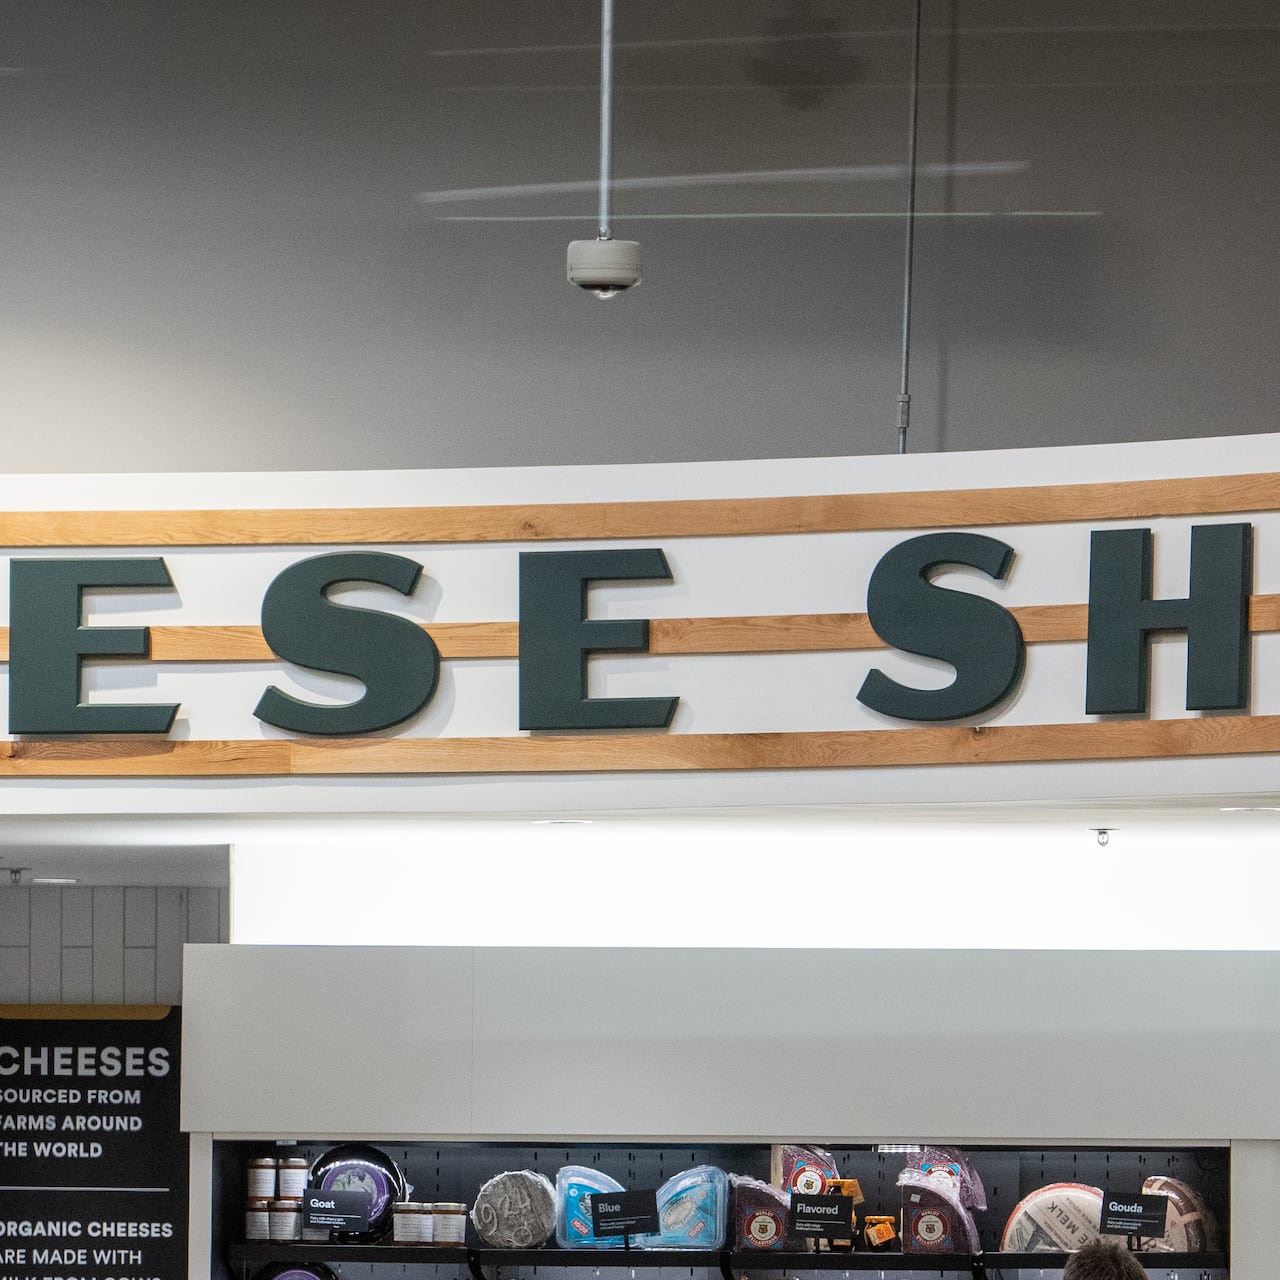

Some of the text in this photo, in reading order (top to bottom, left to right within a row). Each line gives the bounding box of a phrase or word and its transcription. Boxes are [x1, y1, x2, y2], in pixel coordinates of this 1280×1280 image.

[87, 1089, 141, 1104] FROM
[61, 1115, 142, 1131] AROUND
[33, 1142, 103, 1158] WORLD
[310, 1198, 336, 1209] Goat
[598, 1203, 621, 1213] Blue
[796, 1203, 839, 1214] Flavored
[1109, 1201, 1143, 1213] Gouda
[1047, 1201, 1080, 1235] MELK
[87, 1221, 173, 1238] CHEESES
[32, 1248, 87, 1265] MADE
[92, 1249, 142, 1265] WITH
